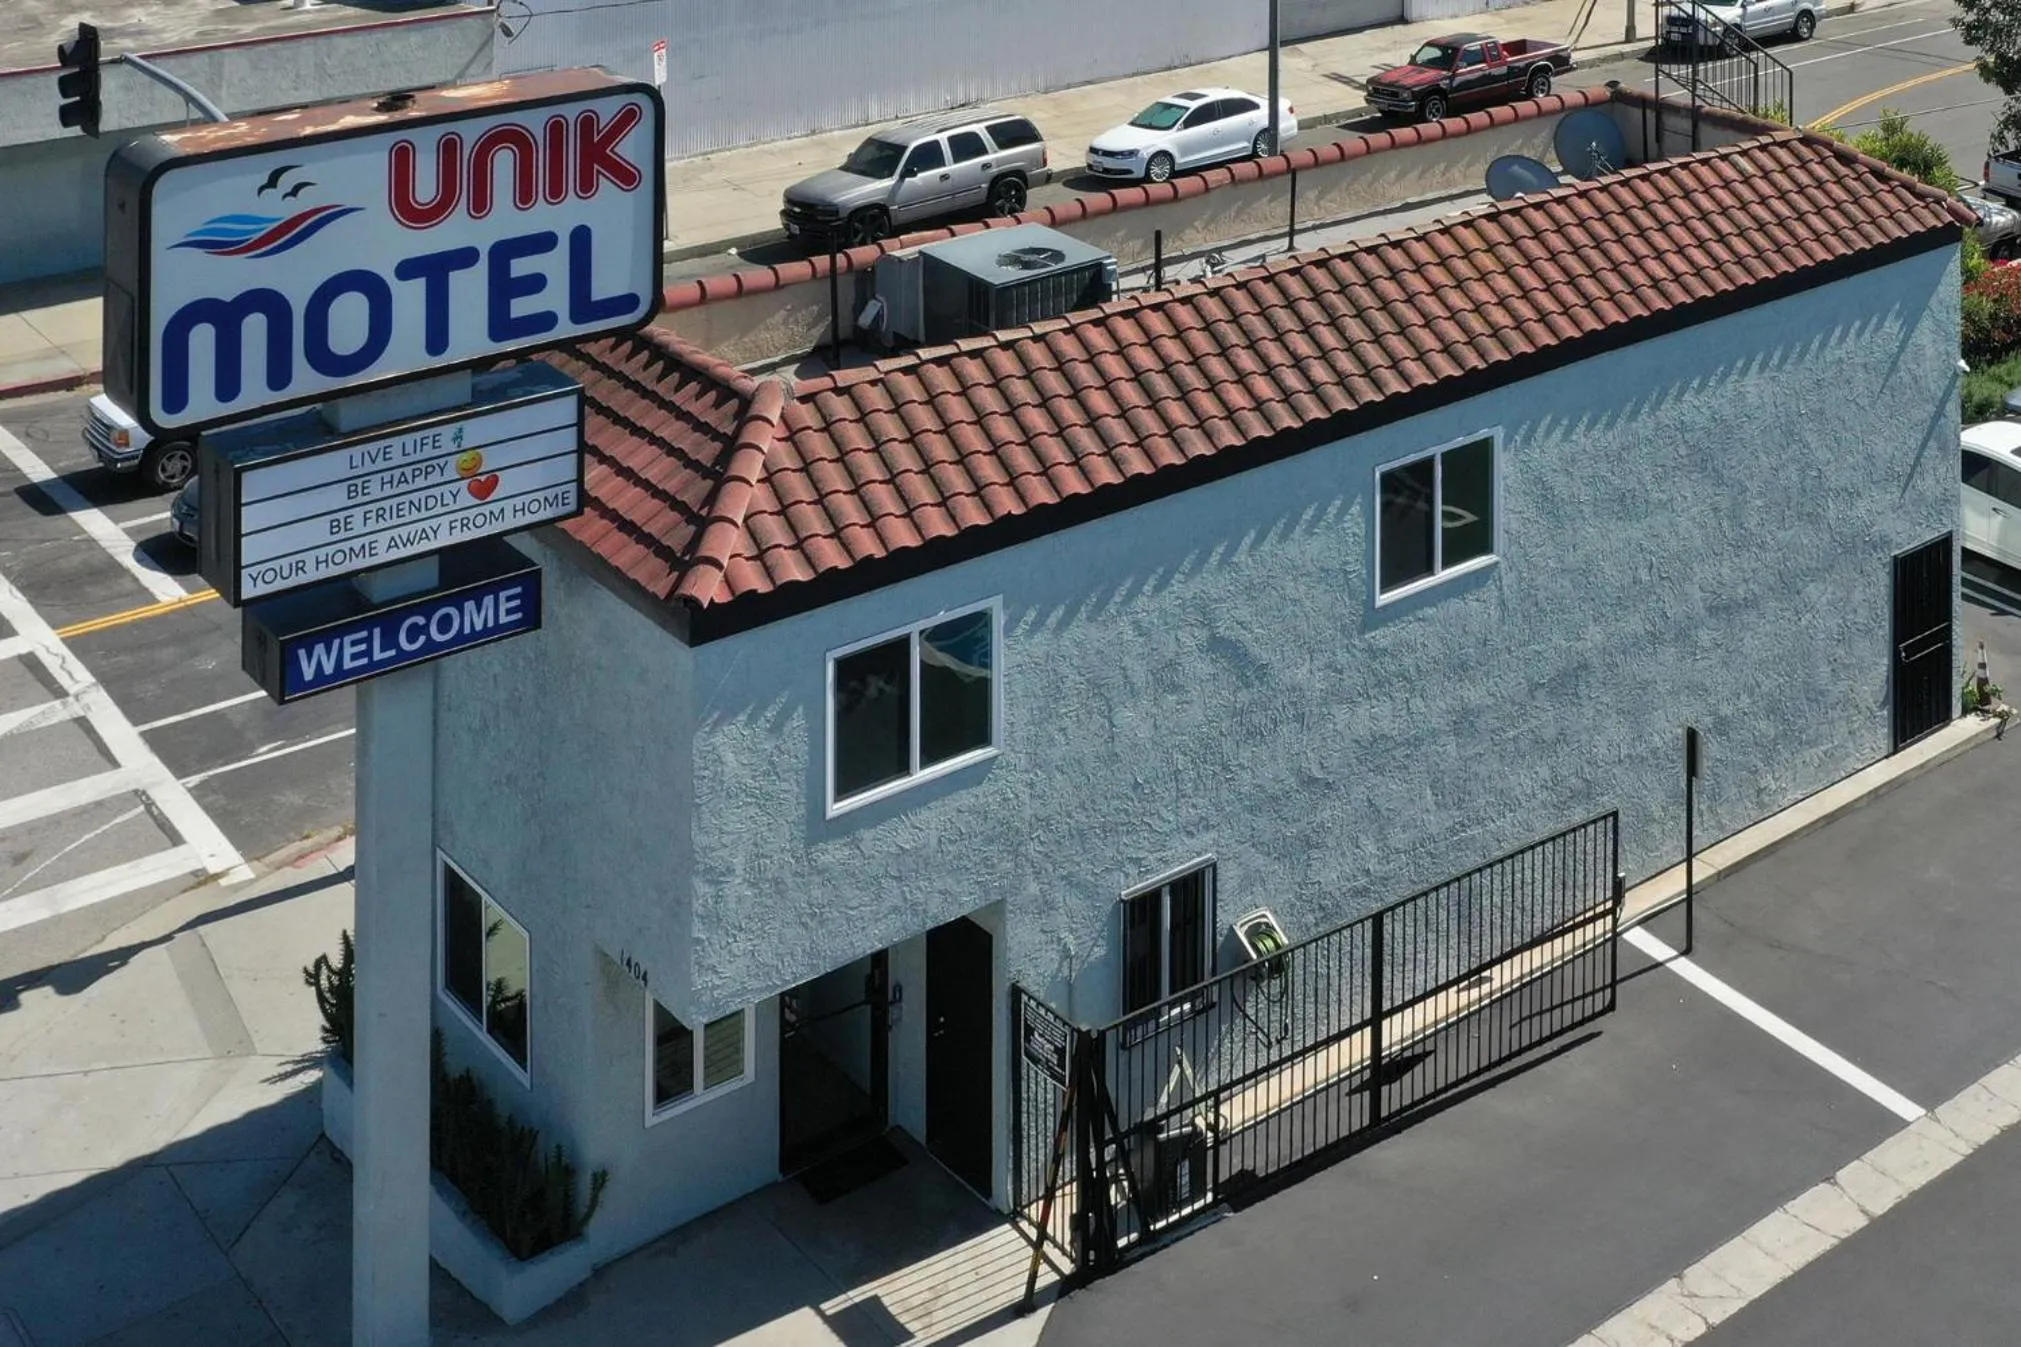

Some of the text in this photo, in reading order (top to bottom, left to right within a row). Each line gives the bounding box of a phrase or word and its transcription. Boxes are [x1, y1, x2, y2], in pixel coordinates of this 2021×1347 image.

[388, 102, 643, 230] UNIK
[161, 224, 640, 415] MOTEL
[347, 460, 449, 501] BE HAPPY
[348, 432, 443, 470] LIVE LIFE
[248, 490, 572, 589] YOUR HOME AWAY FROM HOME
[329, 488, 462, 536] BE FRIENDLY
[297, 586, 524, 682] WELCOME
[620, 948, 649, 988] 1404
